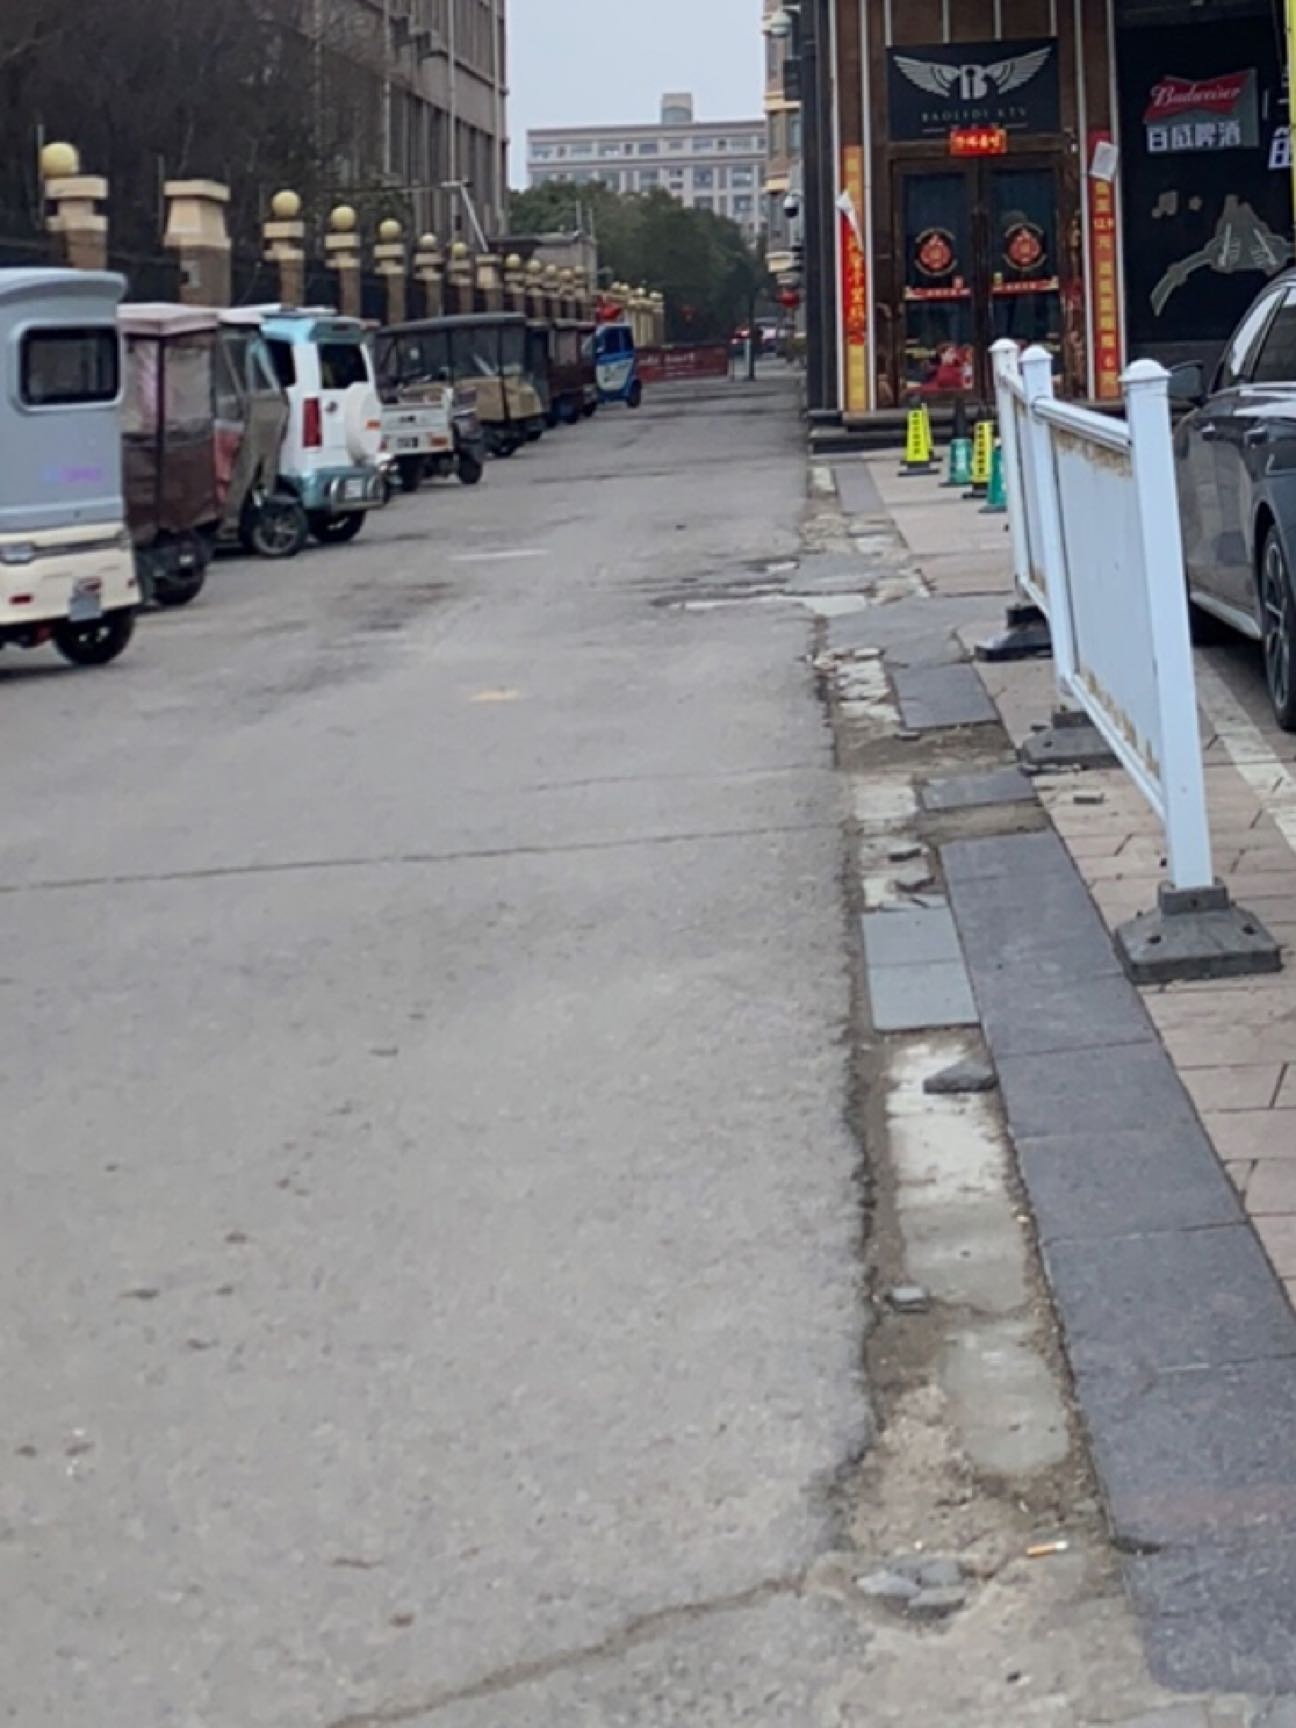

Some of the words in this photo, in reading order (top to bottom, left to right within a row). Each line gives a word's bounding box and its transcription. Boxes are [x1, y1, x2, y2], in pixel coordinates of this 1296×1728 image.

[1151, 83, 1241, 108] Budweiser
[1146, 120, 1241, 153] 百威啤酒
